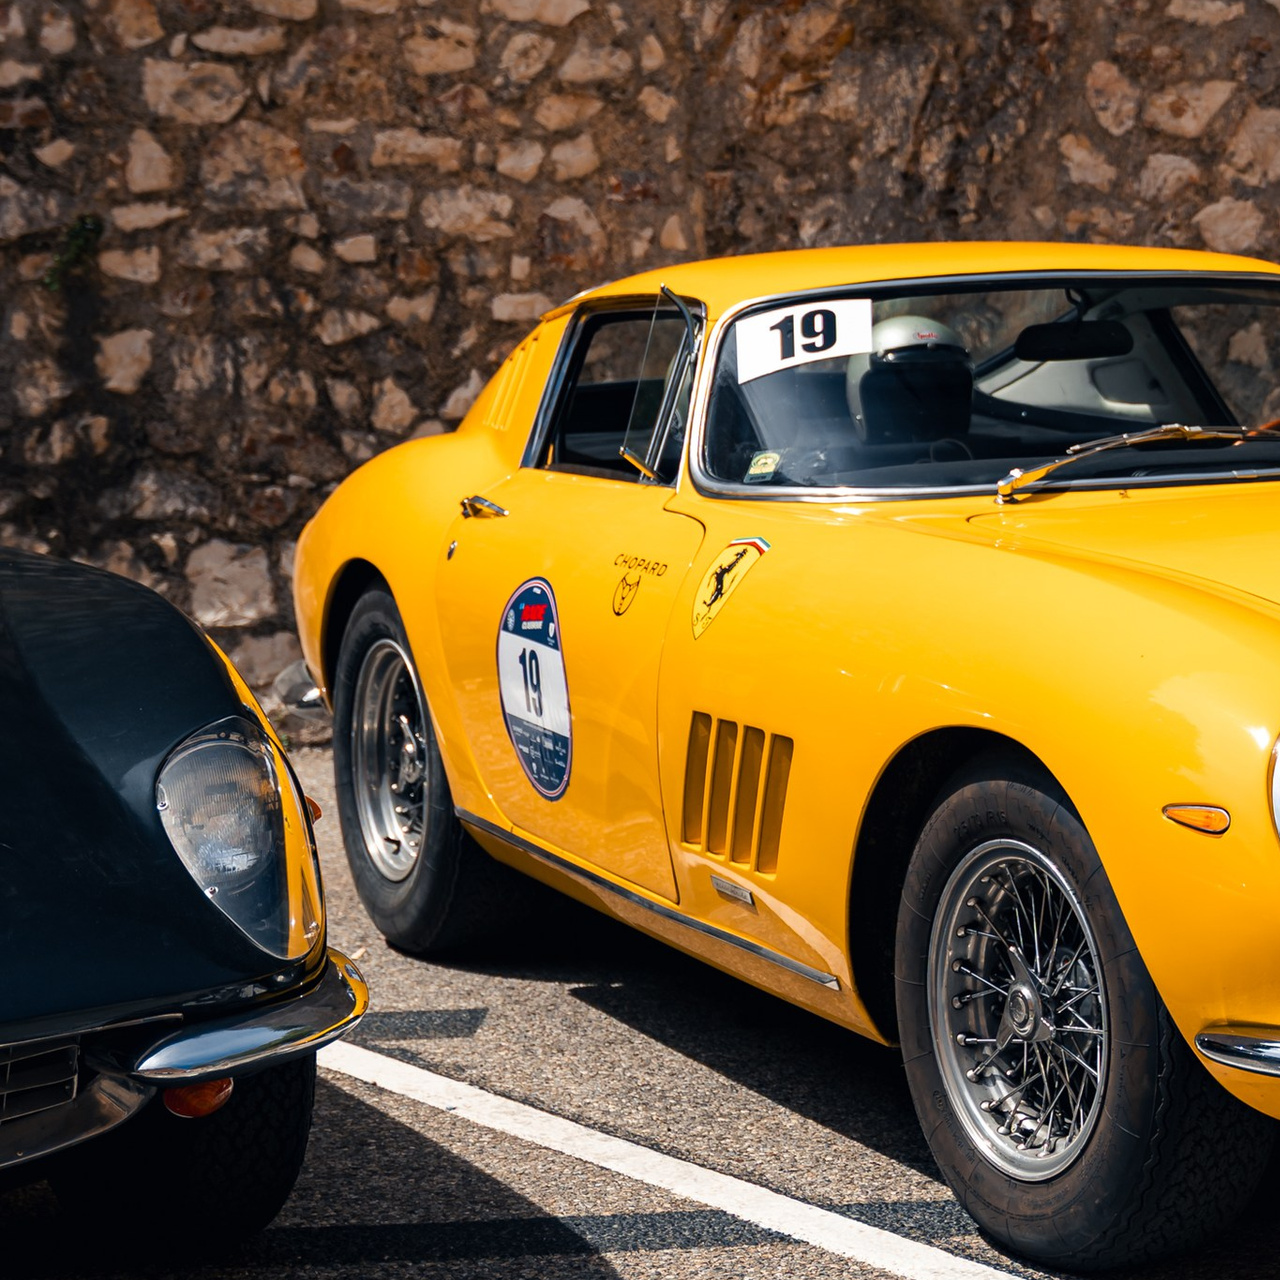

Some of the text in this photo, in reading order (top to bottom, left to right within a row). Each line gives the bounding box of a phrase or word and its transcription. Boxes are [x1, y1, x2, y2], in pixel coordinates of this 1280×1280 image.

[769, 309, 836, 360] 19
[614, 554, 668, 577] CHOPARD
[518, 647, 543, 718] 19
